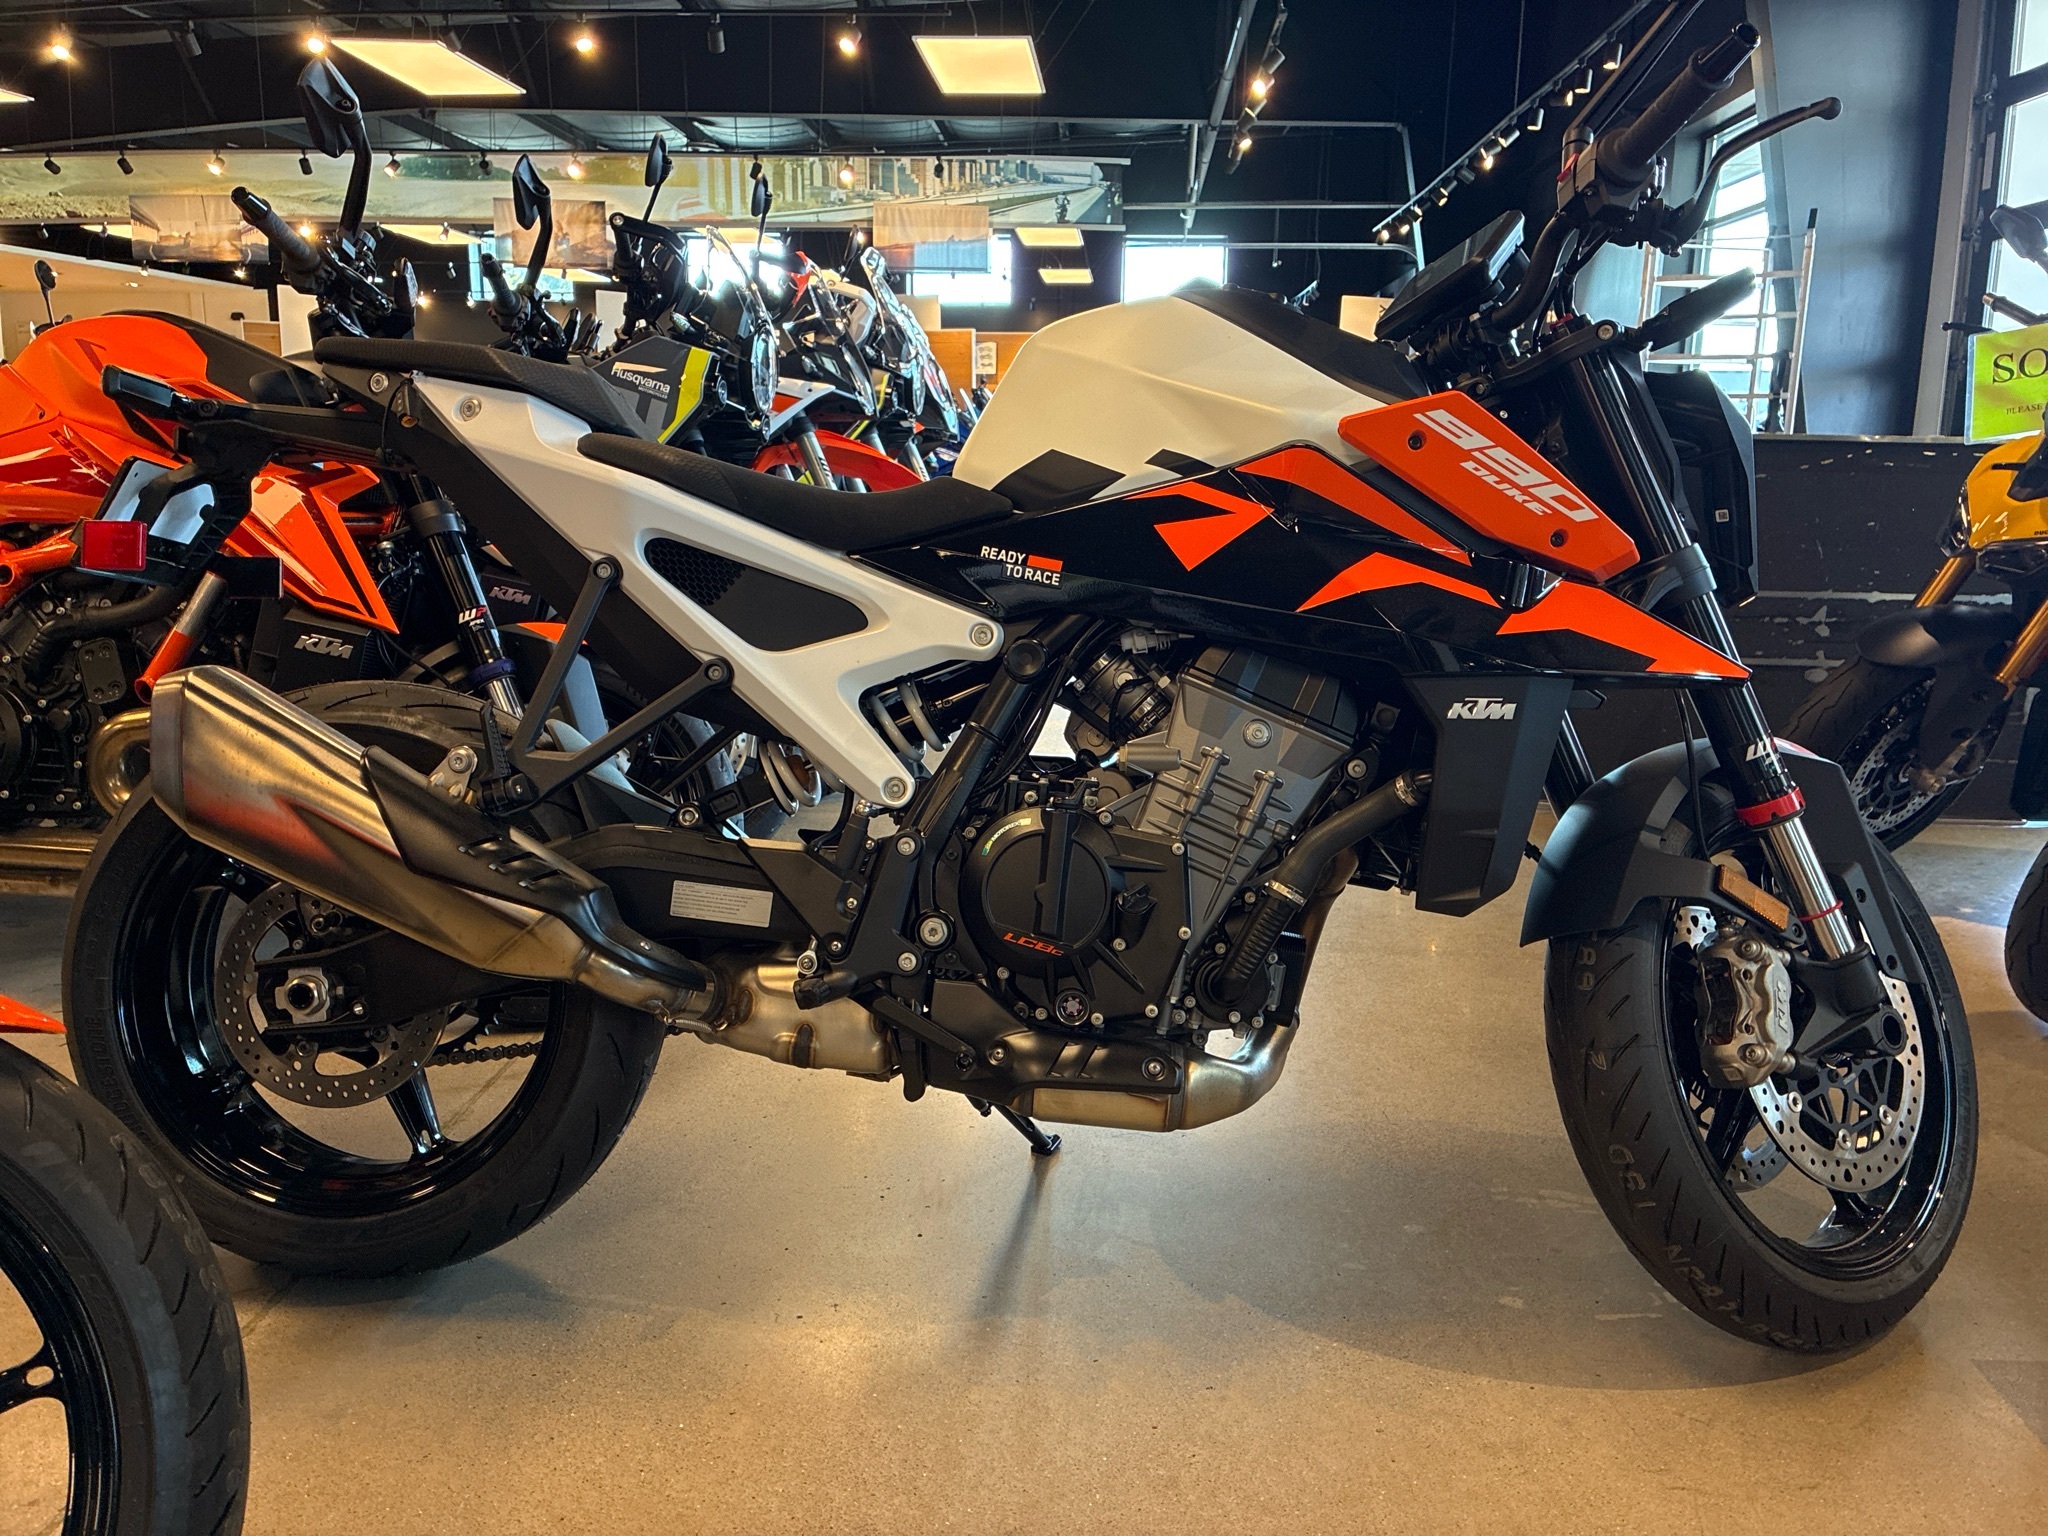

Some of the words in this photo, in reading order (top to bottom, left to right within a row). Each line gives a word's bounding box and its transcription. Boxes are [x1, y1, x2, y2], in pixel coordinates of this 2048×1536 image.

[611, 366, 670, 393] Husqvarna
[1413, 409, 1599, 522] 990
[1459, 460, 1553, 515] DUKE
[980, 545, 1026, 564] READY
[1005, 564, 1022, 578] TO
[1024, 568, 1060, 586] RACE
[489, 585, 532, 605] KTM
[458, 606, 487, 624] WP
[294, 633, 354, 660] KTM
[1446, 697, 1518, 720] KTM
